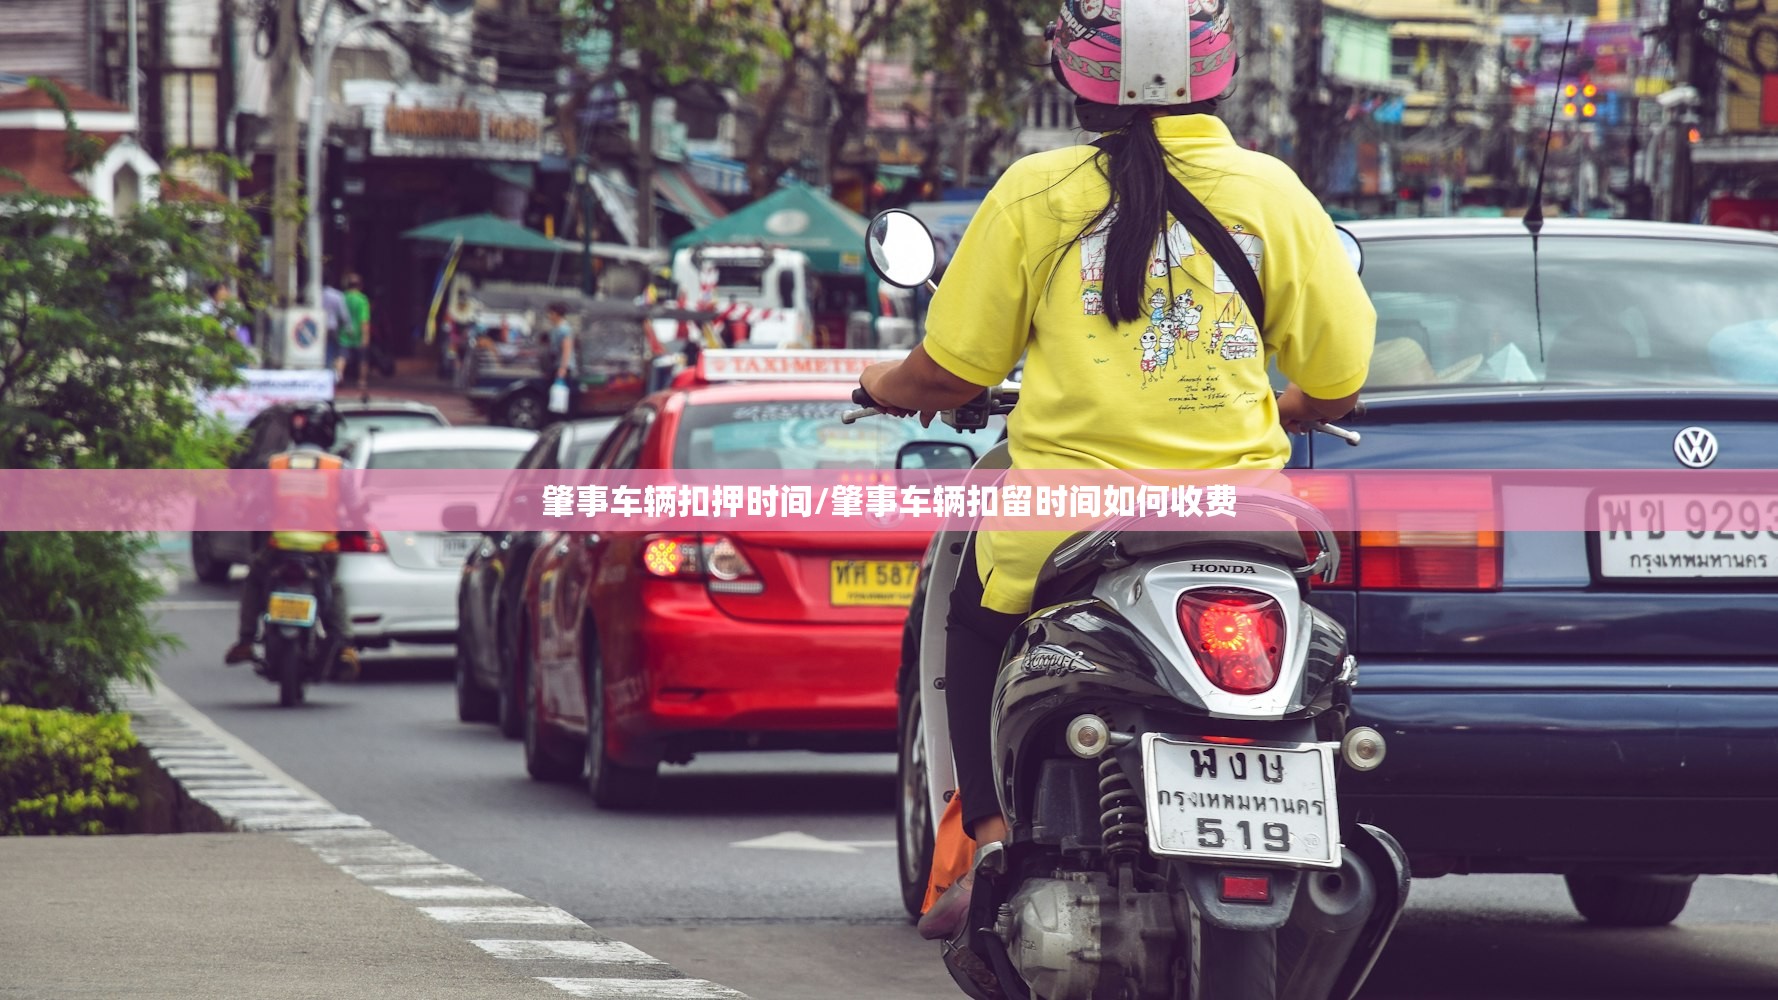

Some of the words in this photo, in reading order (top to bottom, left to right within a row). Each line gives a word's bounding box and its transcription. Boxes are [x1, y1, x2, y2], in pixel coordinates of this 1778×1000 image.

[1191, 563, 1257, 575] HONDA
[1158, 790, 1325, 815] กรุงเทพมหานคร
[1197, 817, 1290, 852] 519
